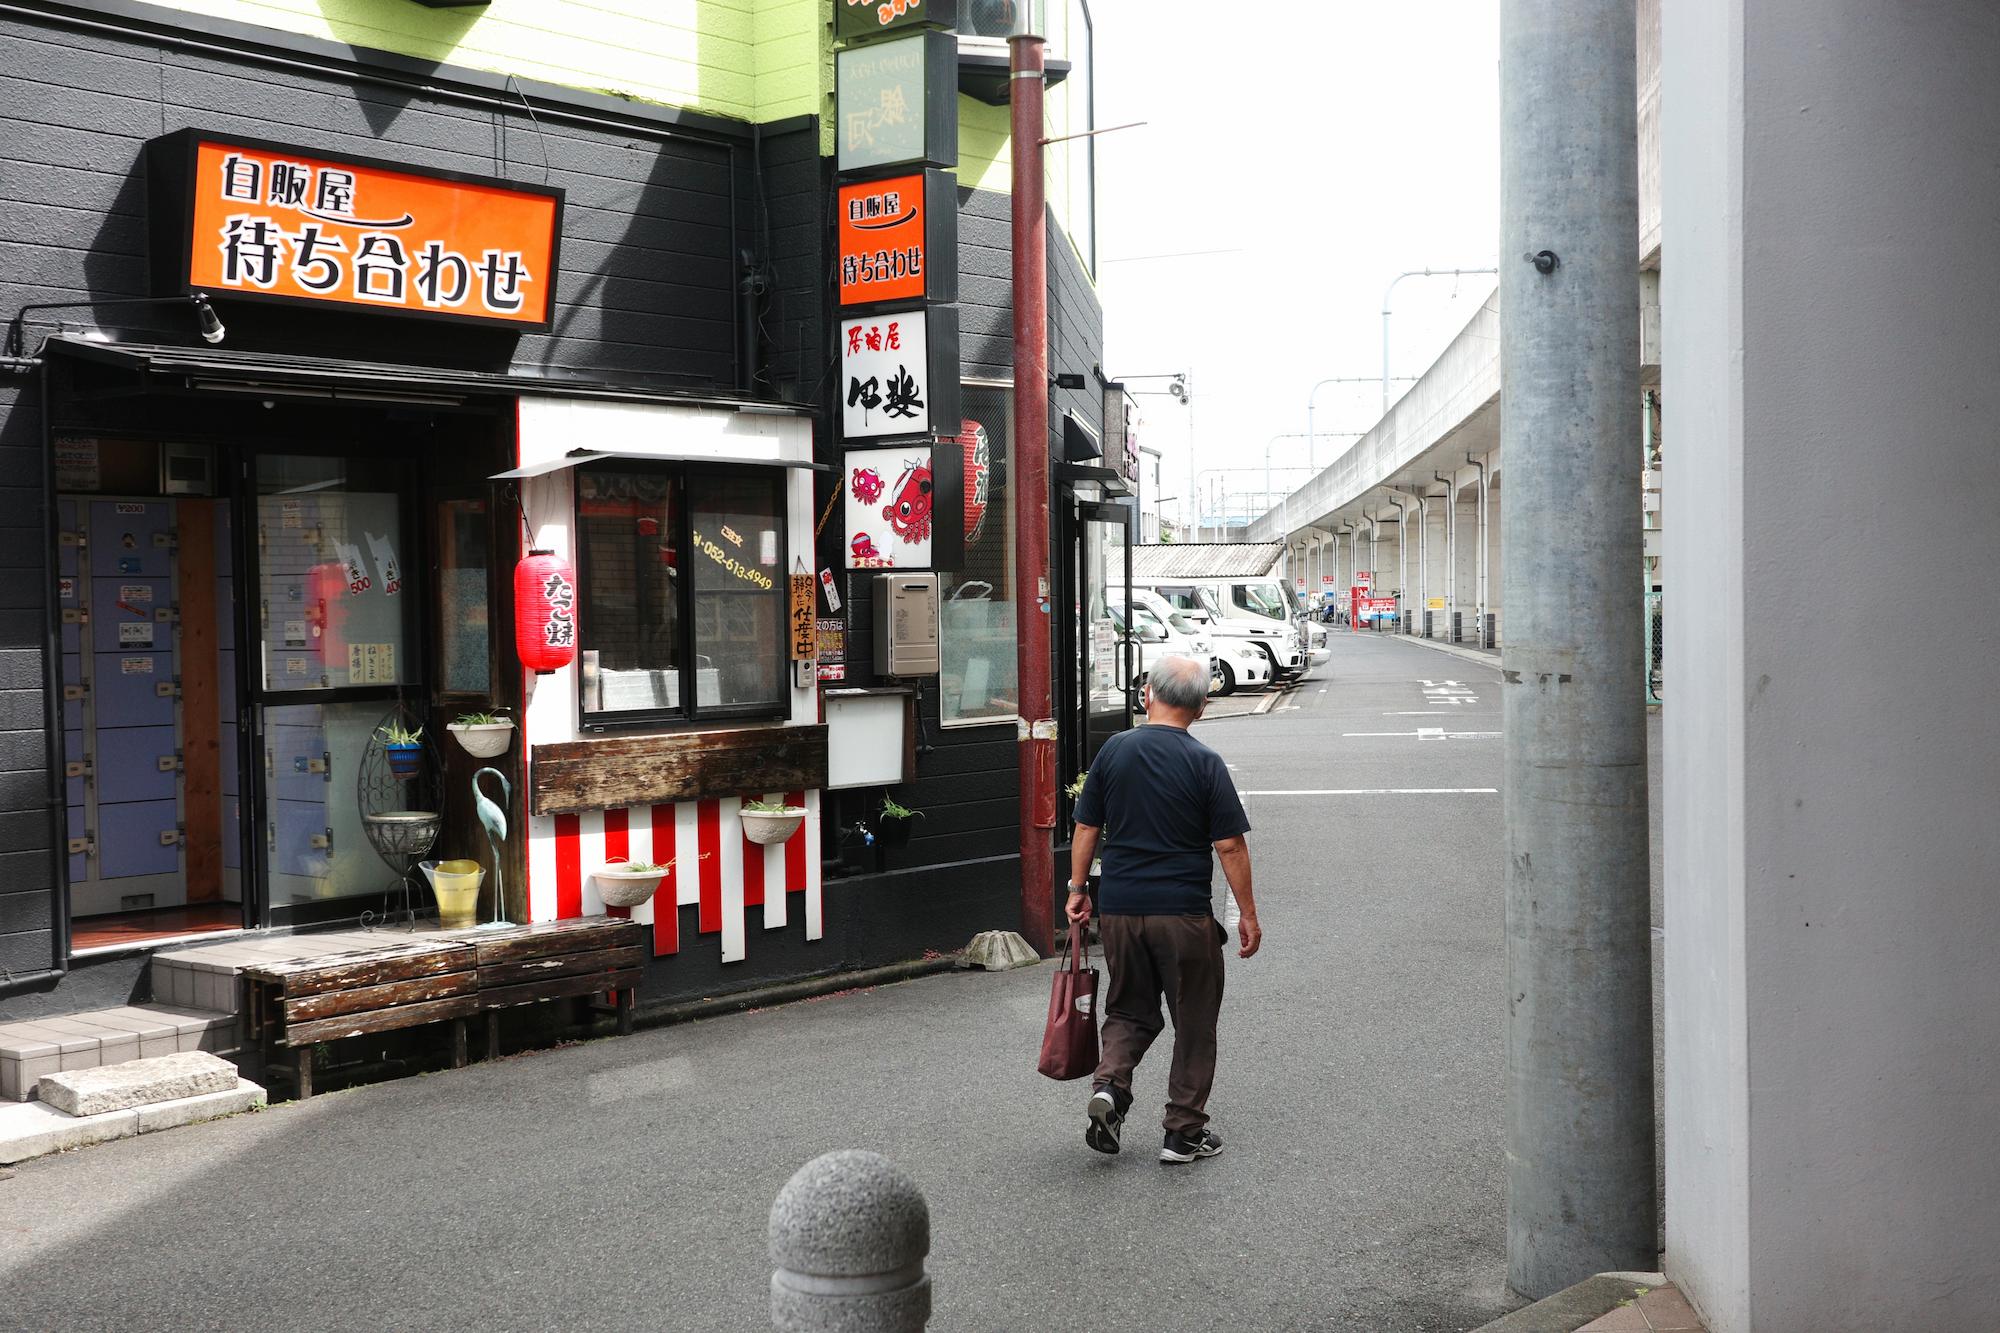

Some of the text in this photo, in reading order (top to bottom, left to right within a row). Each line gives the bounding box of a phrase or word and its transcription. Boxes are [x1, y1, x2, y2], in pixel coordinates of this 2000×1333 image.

[222, 154, 356, 215] 自販屋
[849, 192, 901, 221] 自販屋
[222, 216, 530, 313] 待ち合わせ
[843, 245, 922, 286] 待ち合わせ
[847, 322, 901, 358] 居酒屋
[350, 577, 371, 594] 500
[544, 574, 575, 646] たこ焼
[793, 606, 814, 659] 仕事中
